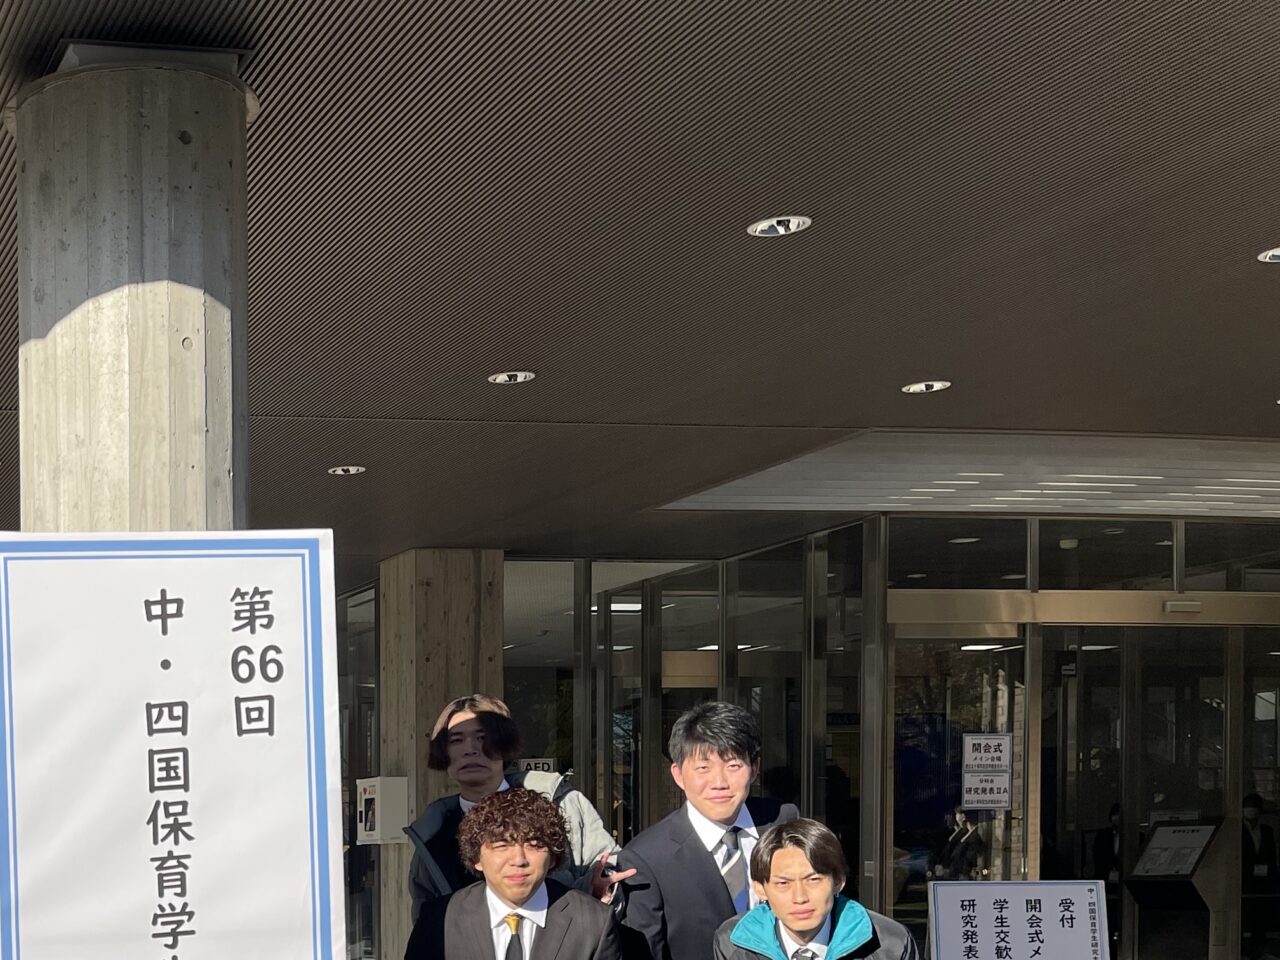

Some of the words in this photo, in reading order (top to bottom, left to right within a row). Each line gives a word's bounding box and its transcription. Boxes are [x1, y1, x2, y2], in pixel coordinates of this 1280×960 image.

[229, 586, 285, 737] 第66回
[971, 742, 1003, 754] 開会式
[1058, 898, 1077, 929] 受付
